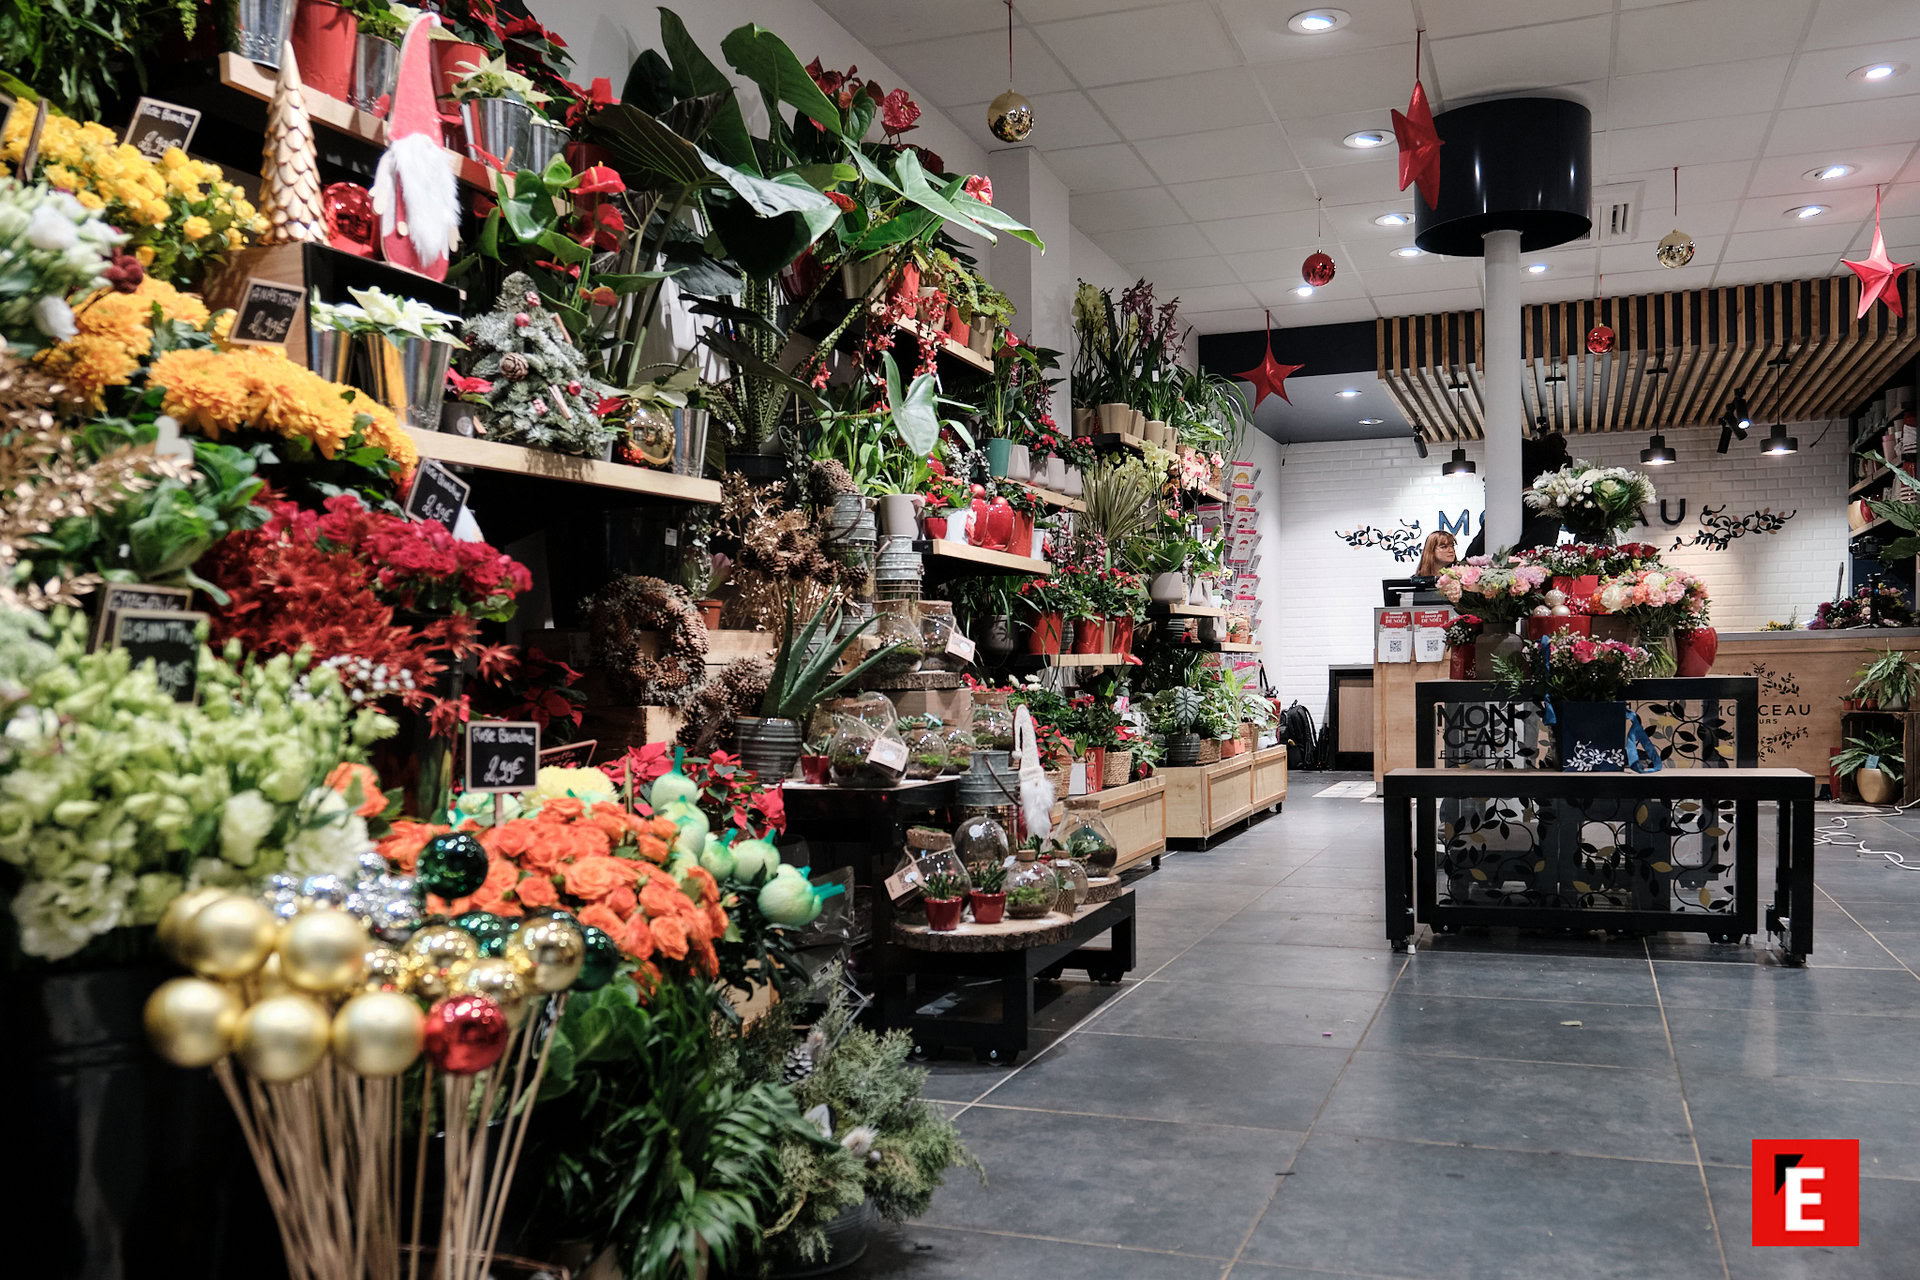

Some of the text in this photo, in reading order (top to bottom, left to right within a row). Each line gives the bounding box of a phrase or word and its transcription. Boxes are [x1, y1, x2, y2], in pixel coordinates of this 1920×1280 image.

[1437, 703, 1515, 729] MON
[1443, 726, 1510, 751] CEAU
[483, 755, 525, 786] 2,99€
